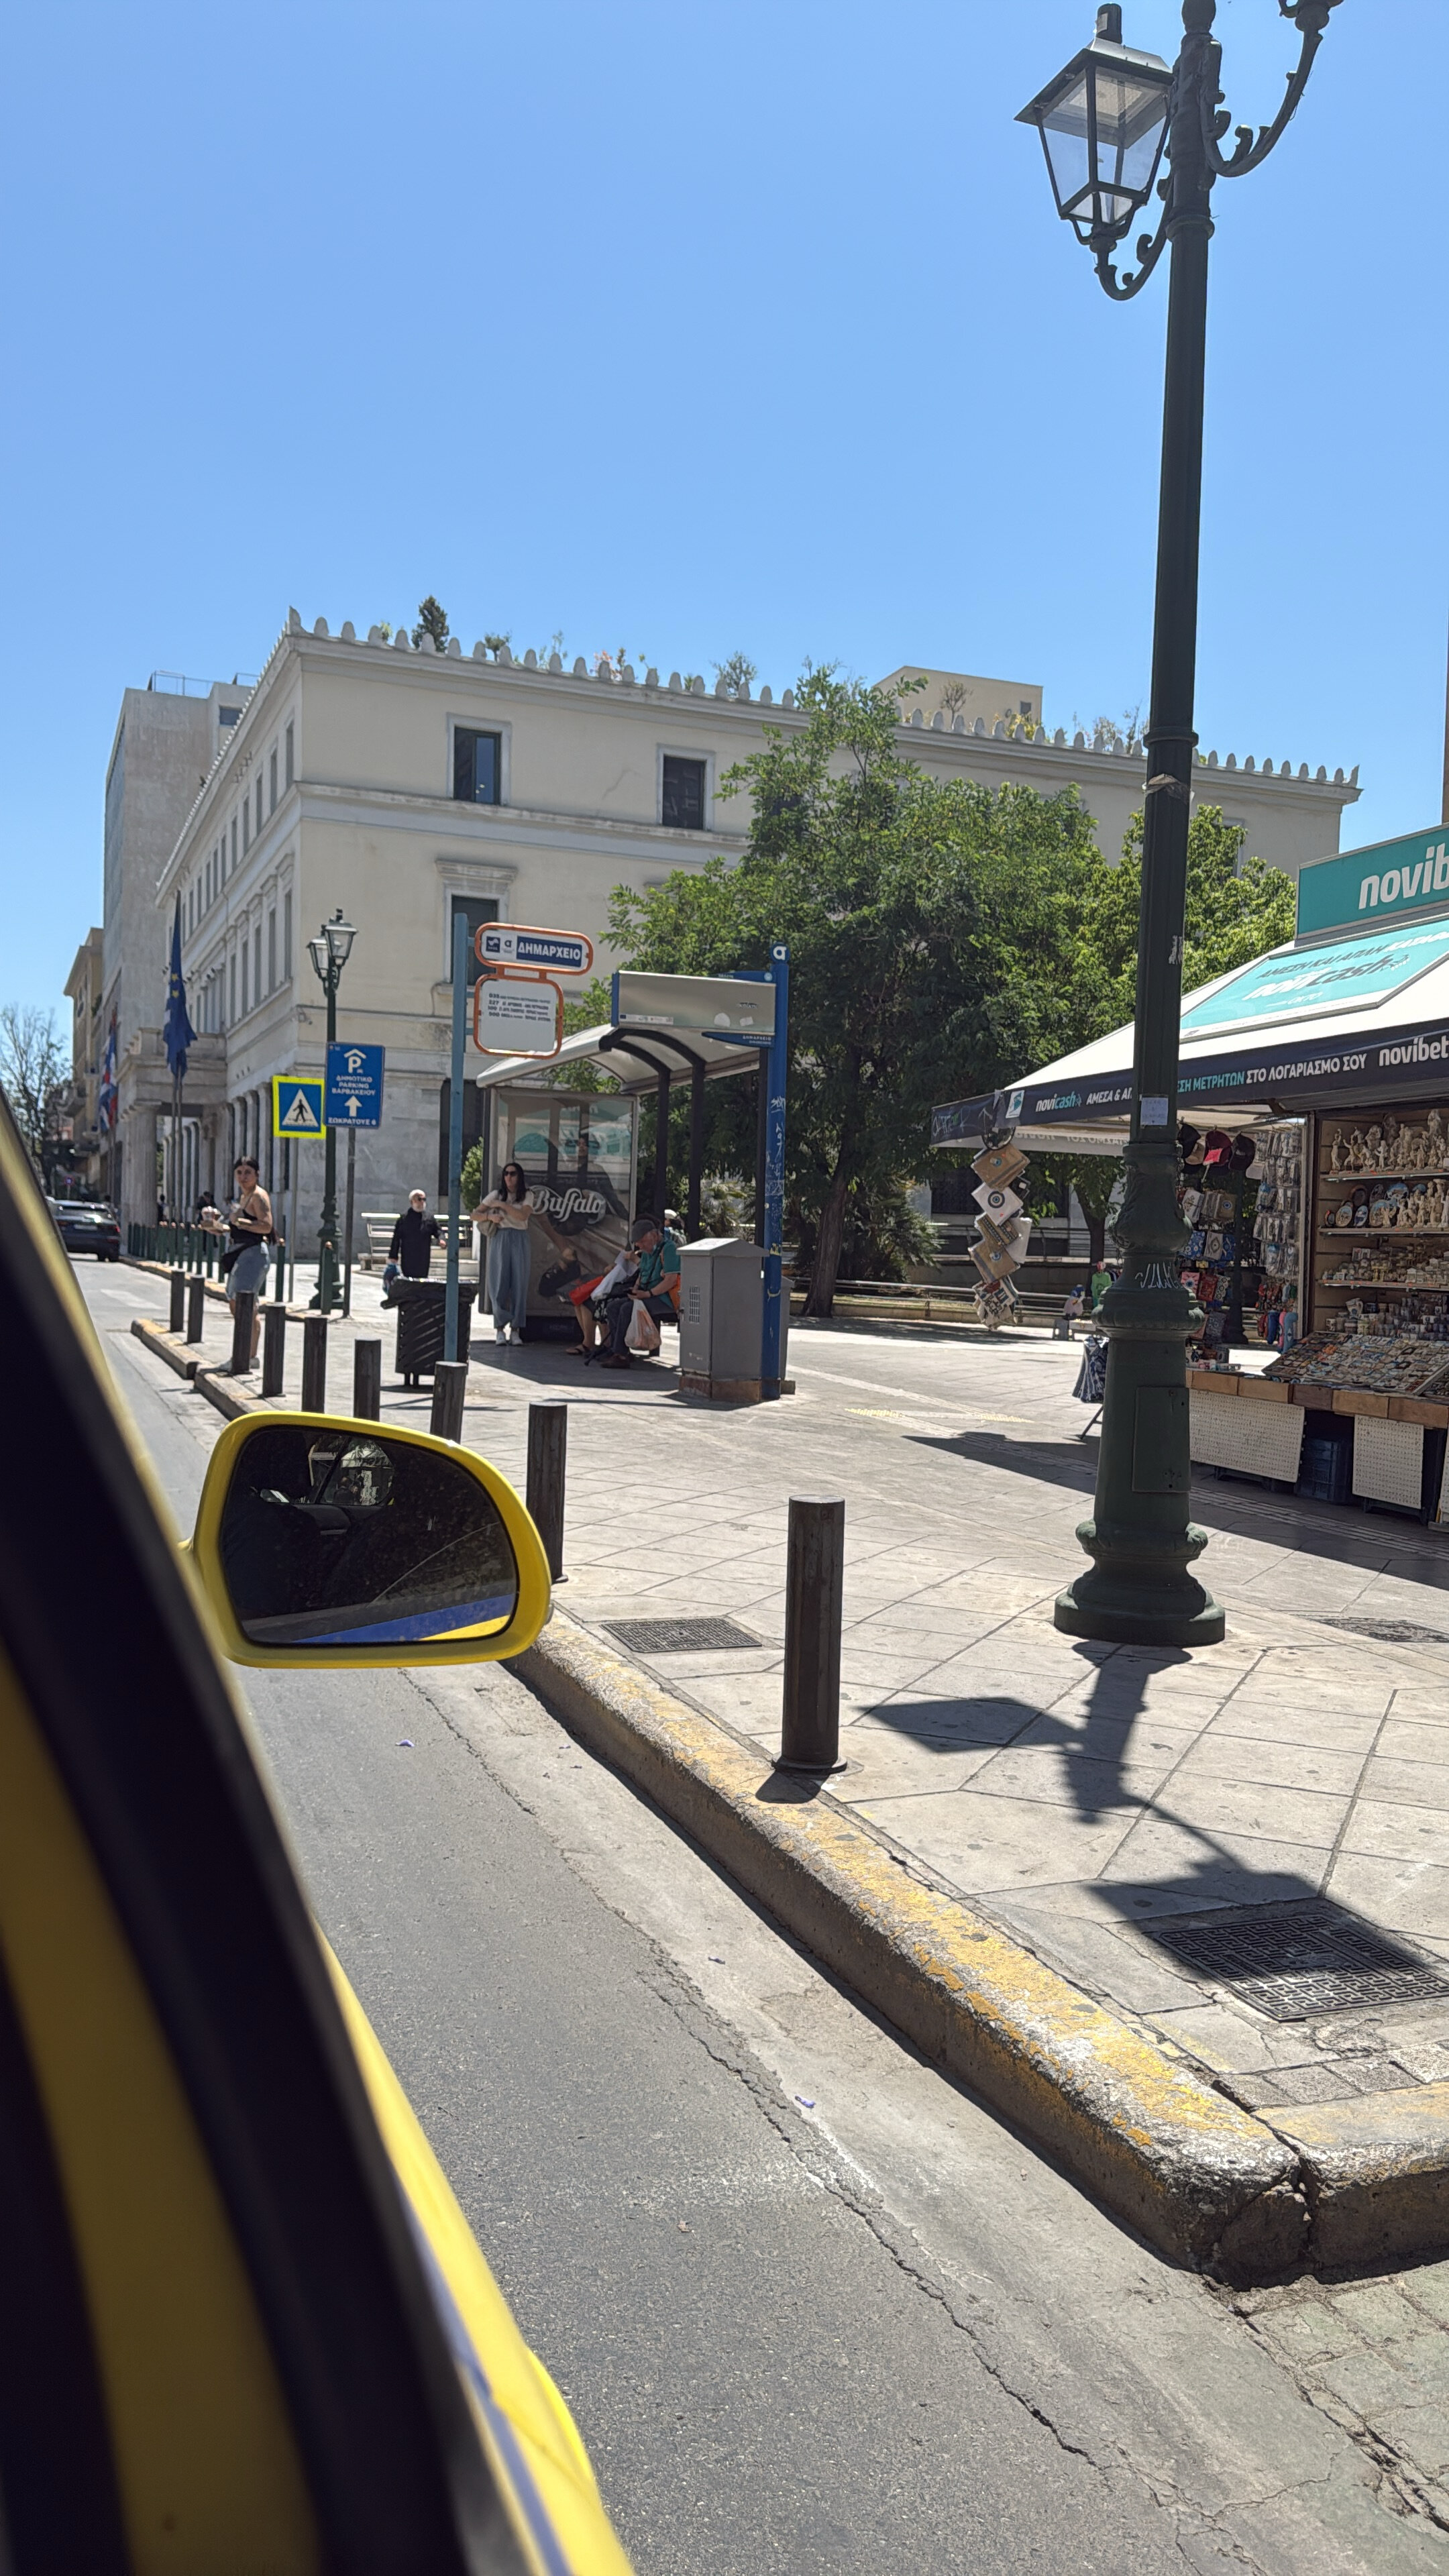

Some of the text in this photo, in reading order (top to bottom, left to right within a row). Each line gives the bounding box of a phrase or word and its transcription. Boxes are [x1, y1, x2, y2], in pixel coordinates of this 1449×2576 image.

[518, 941, 581, 960] ΔΗΜΑΡΧΕΙΟ
[1379, 1035, 1449, 1067] novibet
[336, 1075, 373, 1083] ΔΗΜΟΤΙΚΟ
[1086, 1090, 1113, 1105] ΑΜΕΣΑ
[1114, 1089, 1121, 1101] &
[1193, 1071, 1245, 1091] ΜΕΤΡΗΤΩΝ
[1246, 1068, 1267, 1084] ΣΤΟ
[1268, 1057, 1340, 1081] ΛΟΓΑΡΙΑΣΜΟ
[1343, 1053, 1367, 1071] ΣΟΥ
[331, 1087, 376, 1095] ΒΑΡΒΑΚΕΙΟΥ
[1035, 1091, 1077, 1112] novicash
[328, 1117, 370, 1126] ΣΩΚΡΑΤΟΥΣ
[531, 1185, 606, 1223] Buffalo
